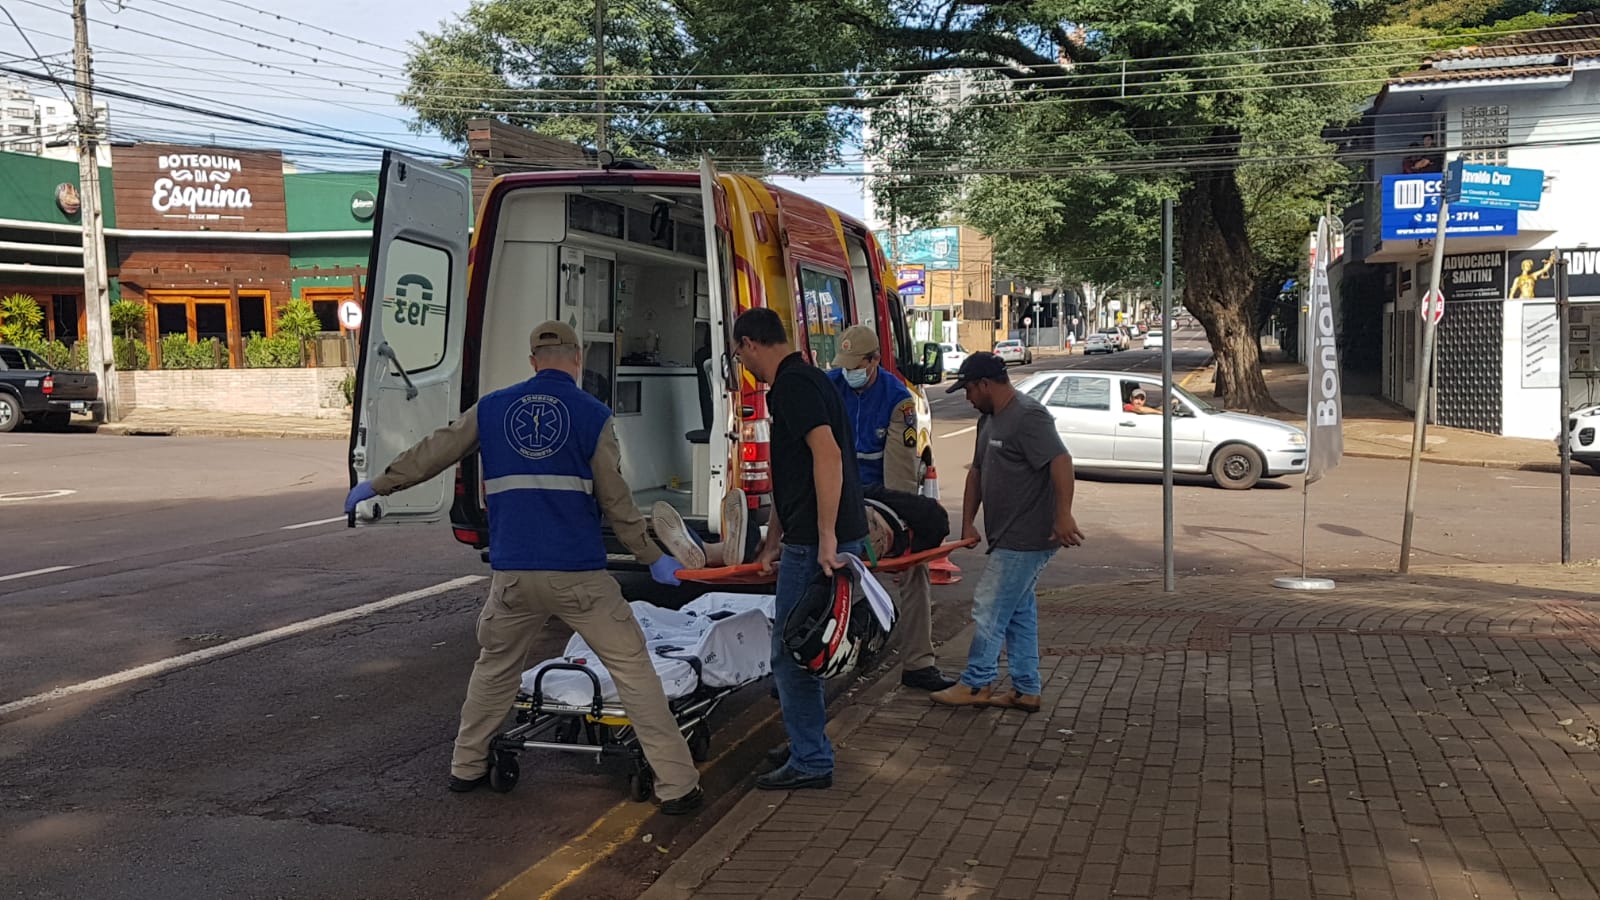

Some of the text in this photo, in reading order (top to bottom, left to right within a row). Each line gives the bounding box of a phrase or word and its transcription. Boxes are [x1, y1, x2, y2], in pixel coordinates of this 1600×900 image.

[158, 154, 241, 172] BOTEQUIM
[194, 169, 208, 182] DA
[1492, 171, 1512, 186] Cruz
[152, 178, 253, 213] Esquina
[1456, 211, 1480, 221] 2714
[1444, 253, 1501, 270] ADVOCACIA
[1452, 268, 1493, 284] SANTINI
